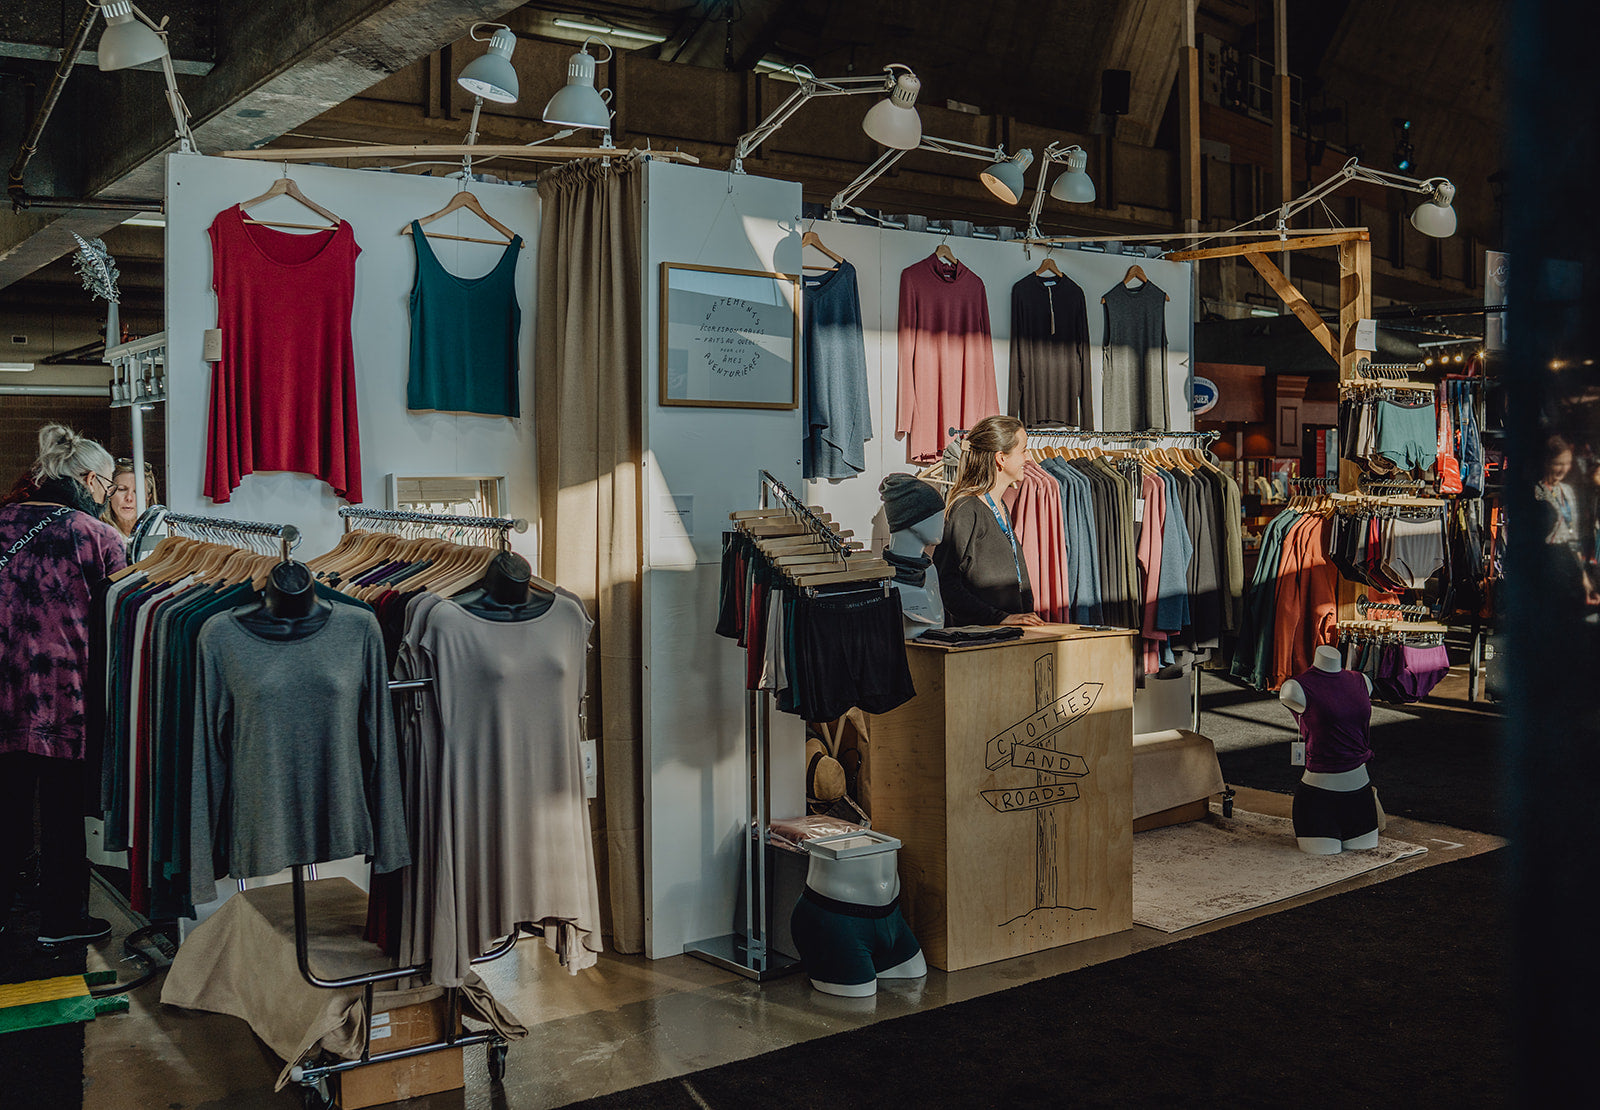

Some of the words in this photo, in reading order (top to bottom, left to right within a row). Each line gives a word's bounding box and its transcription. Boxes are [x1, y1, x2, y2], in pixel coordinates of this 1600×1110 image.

[704, 352, 760, 377] AVENTURIÈRES
[7, 516, 52, 554] NAUTICA
[997, 691, 1091, 755] CLOTHES
[1024, 751, 1071, 771] AND
[1001, 787, 1066, 809] ROADS
